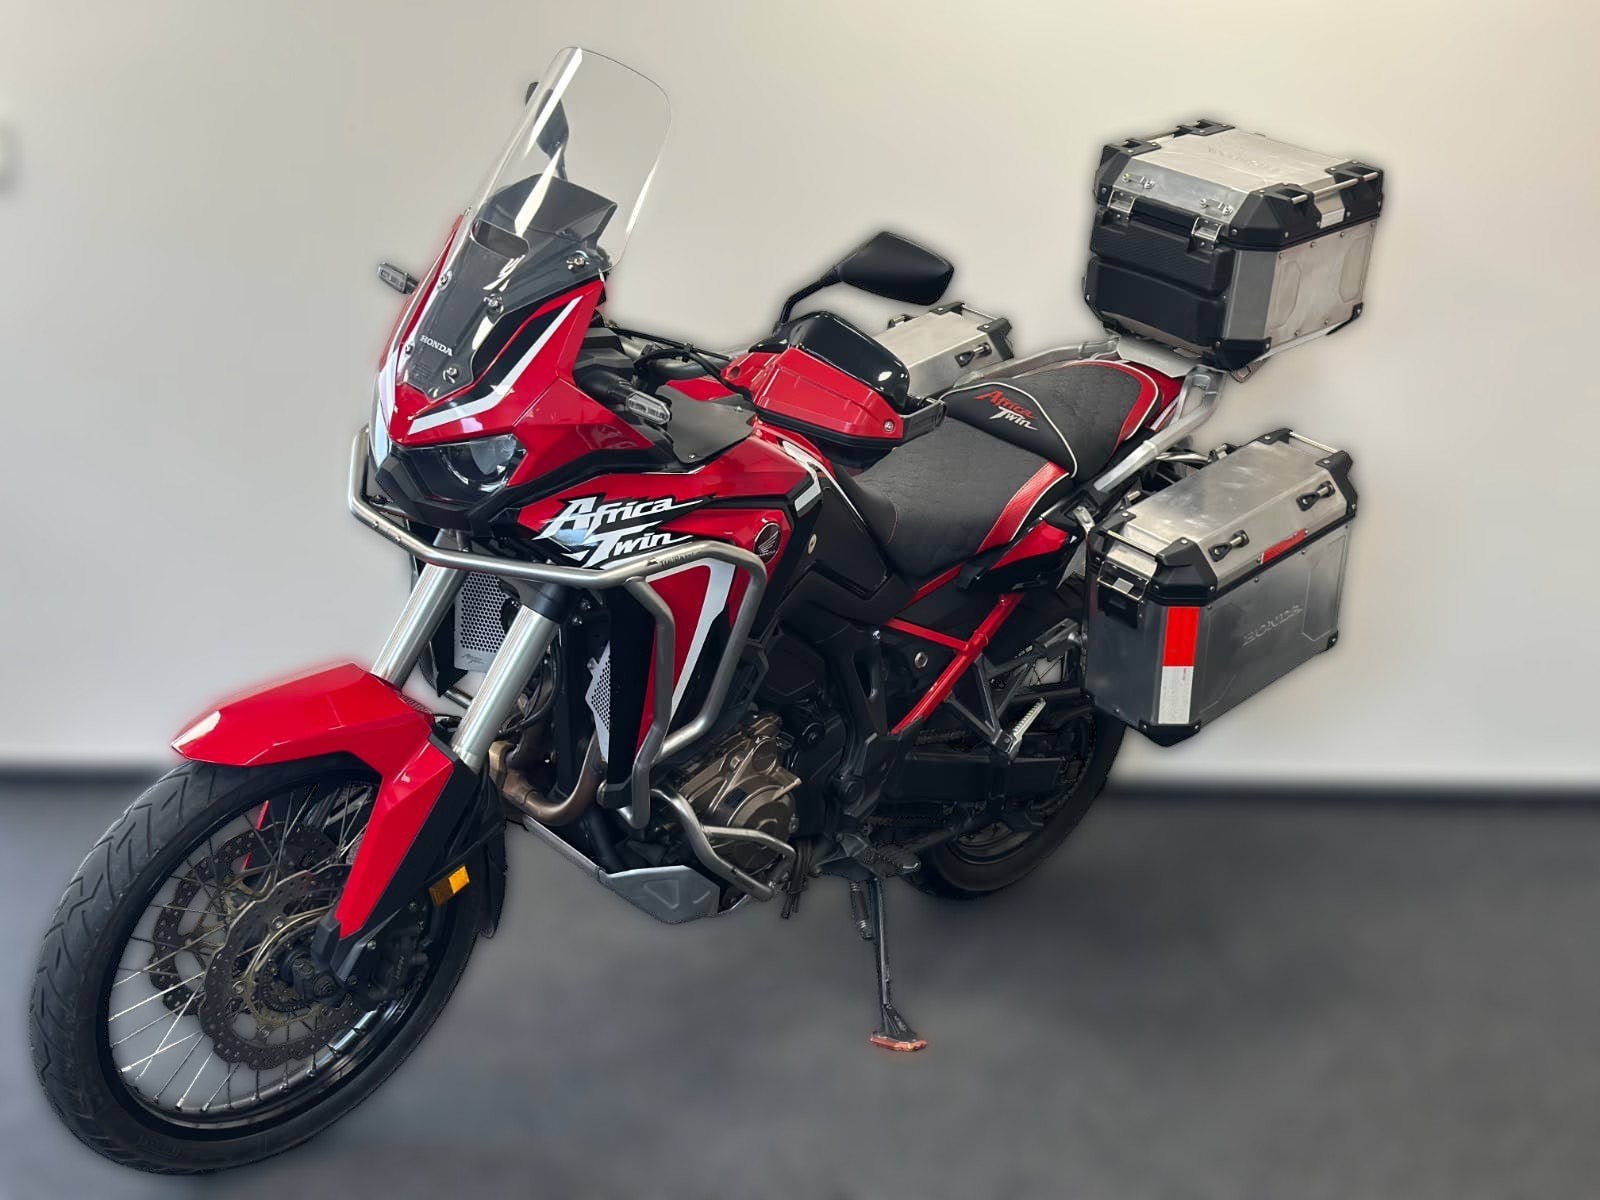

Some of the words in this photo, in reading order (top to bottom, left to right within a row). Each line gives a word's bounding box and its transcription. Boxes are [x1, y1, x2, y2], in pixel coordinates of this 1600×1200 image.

[420, 335, 453, 357] HONDA
[989, 405, 1039, 431] Twin
[531, 496, 704, 541] Africa
[560, 520, 695, 569] Twin
